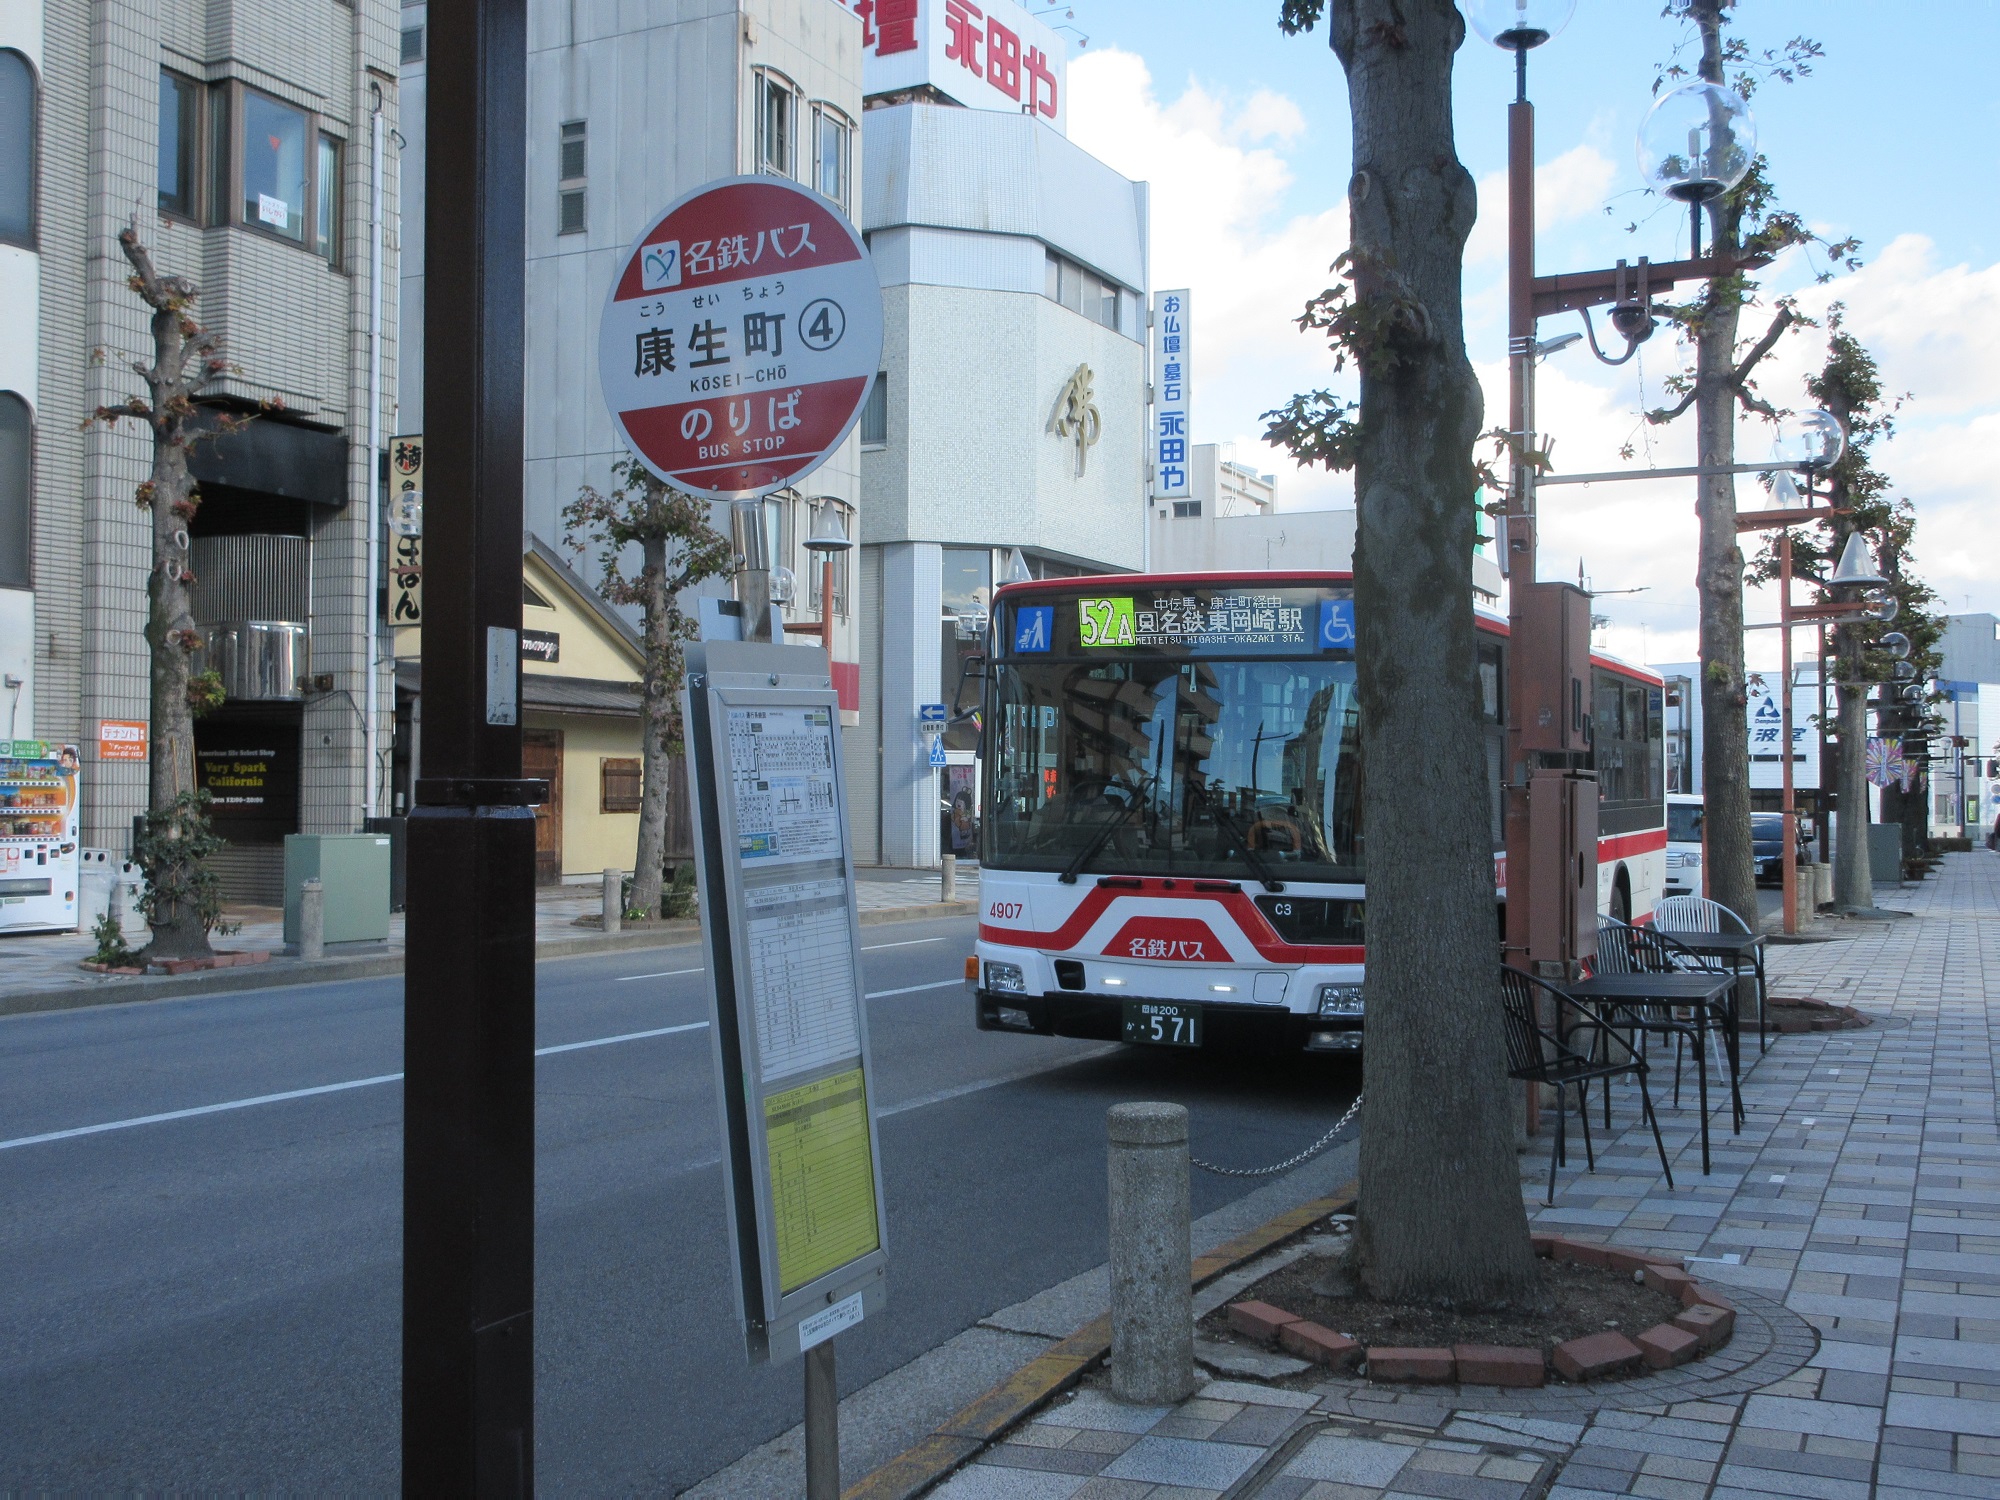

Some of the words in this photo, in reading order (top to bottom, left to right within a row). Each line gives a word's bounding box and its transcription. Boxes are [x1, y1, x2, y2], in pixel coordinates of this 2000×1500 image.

[838, 0, 918, 57] 壇
[945, 0, 1058, 119] 永田や
[684, 222, 816, 276] 名鉄バス
[640, 301, 666, 318] こう
[692, 293, 720, 309] せい
[742, 281, 786, 302] ちょう
[634, 311, 786, 378] 康生町
[1163, 296, 1181, 401] お仏壇・墓石
[680, 389, 802, 442] のりば
[698, 443, 730, 460] BUS
[742, 436, 786, 453] STOP
[1160, 411, 1185, 490] 永田や
[1153, 595, 1282, 611] 中伝馬・康生町経由
[1080, 599, 1135, 646] 52A
[1160, 608, 1304, 634] 名鉄東岡崎駅
[1135, 635, 1182, 645] MEITETSU
[1187, 634, 1275, 645] HIGASHI-OKAZAKI
[1282, 633, 1305, 644] STA.
[104, 728, 137, 739] テナント
[1747, 727, 1807, 742] 波堂
[259, 749, 276, 758] Shop
[233, 762, 267, 775] Spark
[208, 776, 264, 787] California
[990, 903, 1023, 919] 4907
[1275, 902, 1292, 916] C3
[1129, 938, 1205, 960] 名鉄バス
[1126, 1021, 1135, 1031] か
